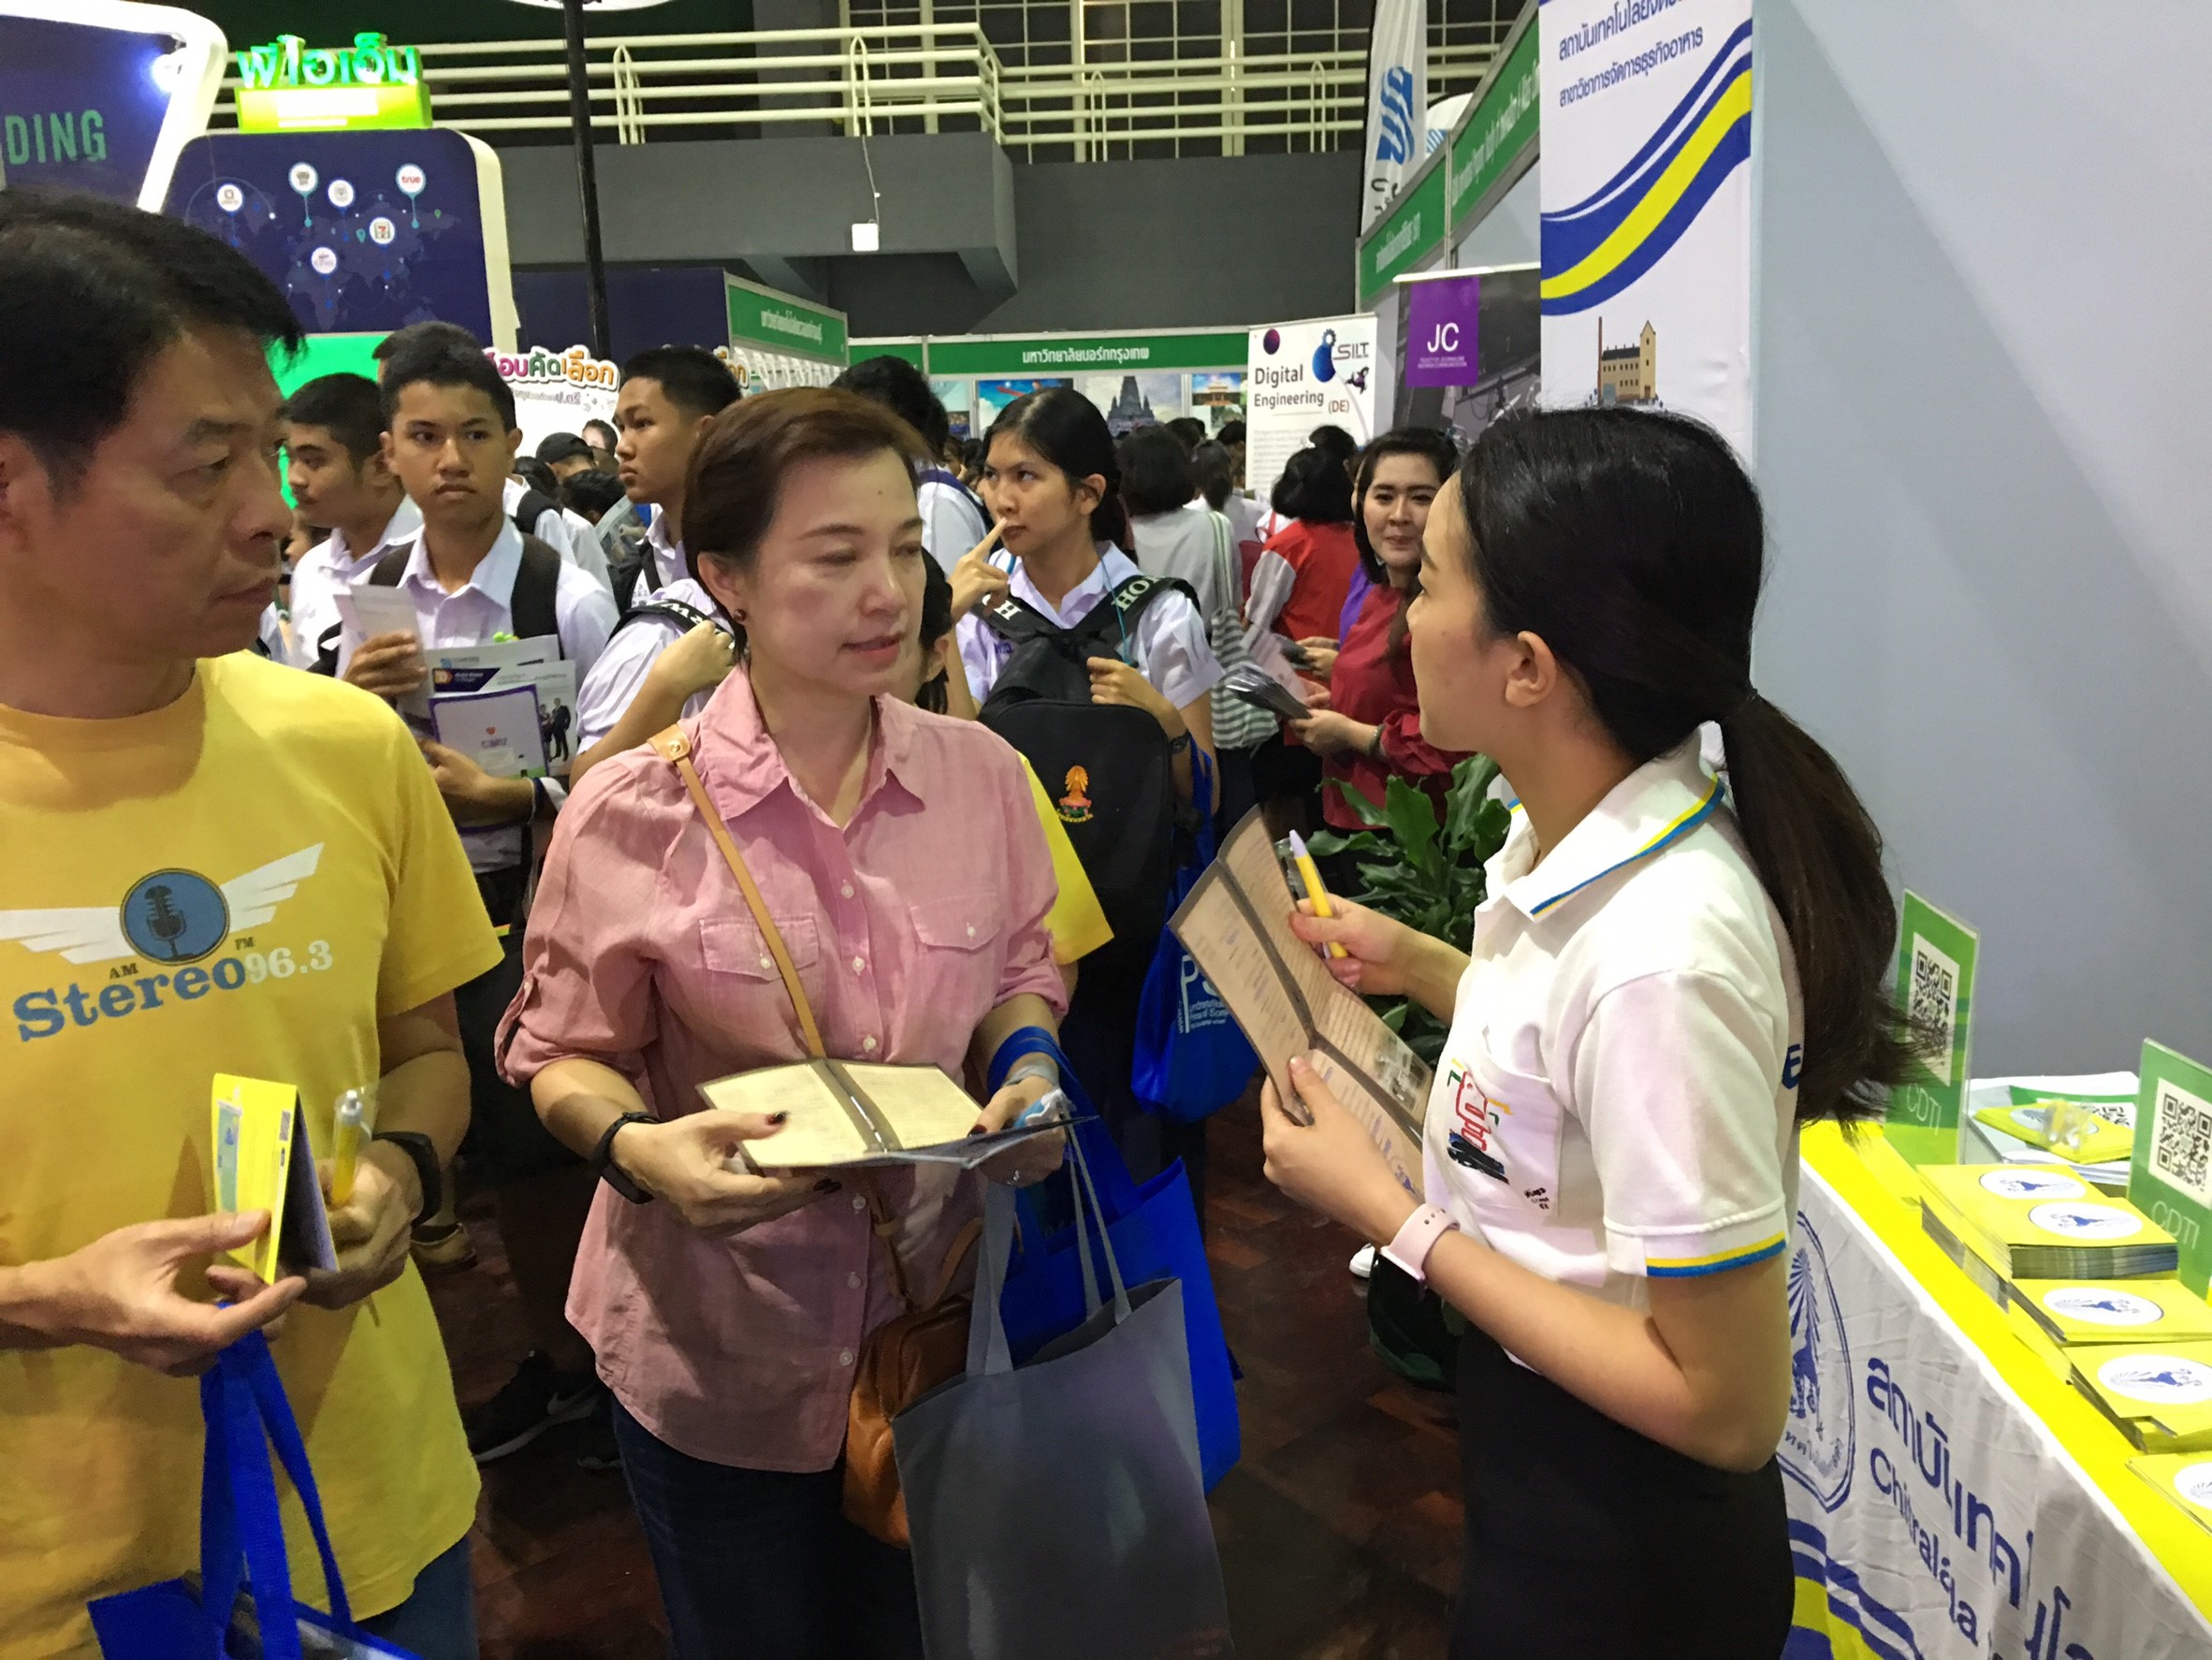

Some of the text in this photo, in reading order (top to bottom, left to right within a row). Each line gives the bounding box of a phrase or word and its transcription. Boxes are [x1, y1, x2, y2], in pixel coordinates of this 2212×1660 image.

[1559, 26, 1704, 107] สาขาวิชาการจัดการธุรกิจอาหาร
[5, 109, 107, 165] DING
[1332, 342, 1370, 360] SILT
[1427, 322, 1460, 353] JC
[1255, 364, 1303, 388] Digital
[1254, 391, 1324, 410] Engineering
[1328, 400, 1350, 415] (DE)
[109, 963, 138, 979] AM
[13, 939, 333, 1042] Stereo 96.3
[1907, 1083, 1943, 1136] CDTI
[2151, 1201, 2201, 1250] CDTI
